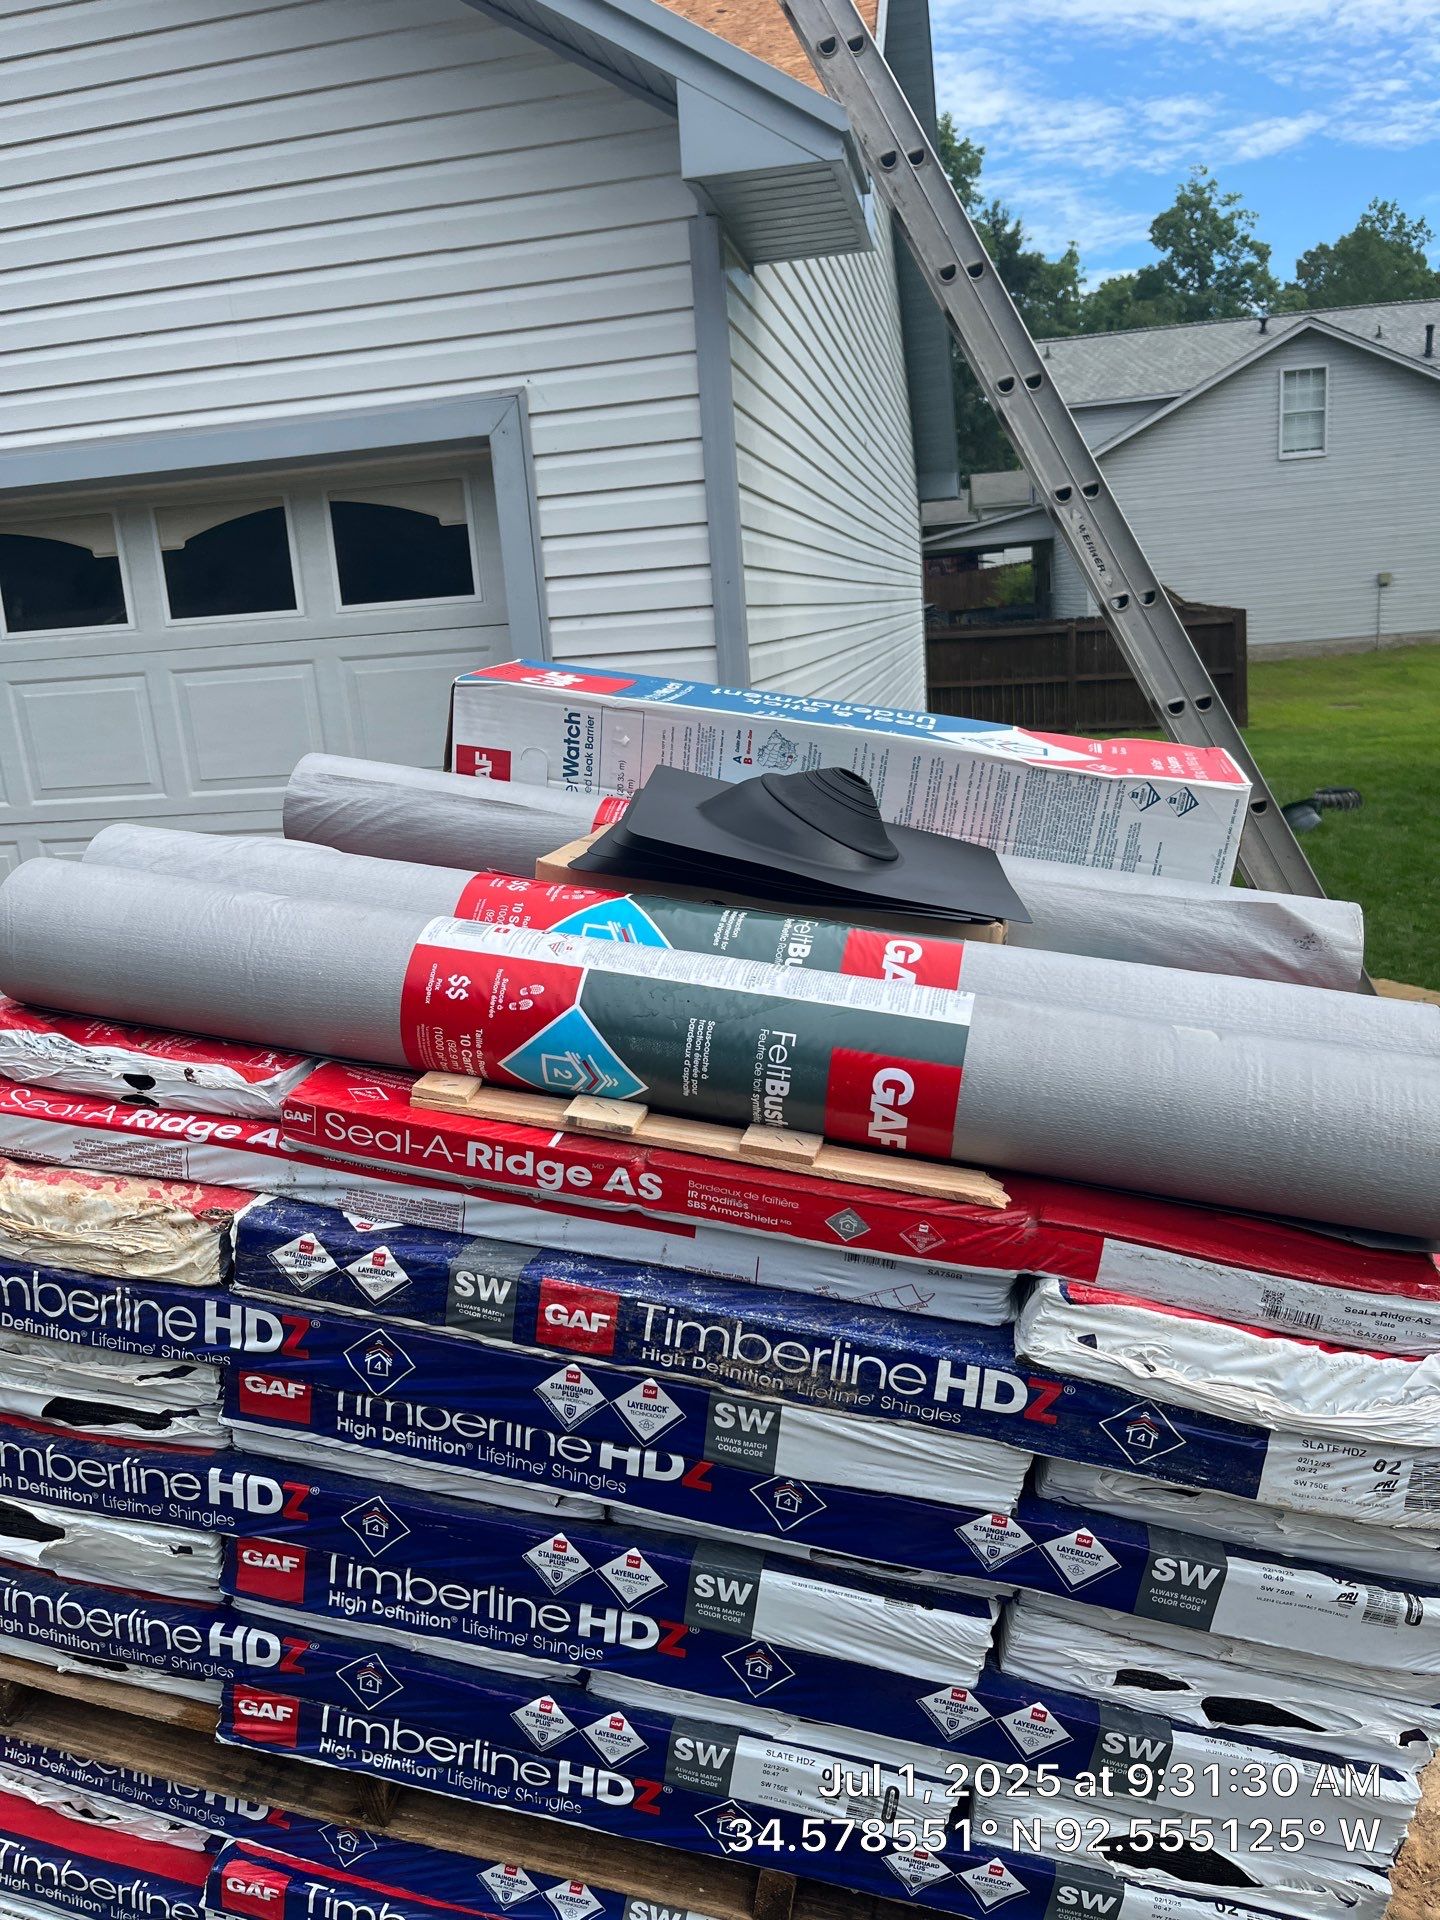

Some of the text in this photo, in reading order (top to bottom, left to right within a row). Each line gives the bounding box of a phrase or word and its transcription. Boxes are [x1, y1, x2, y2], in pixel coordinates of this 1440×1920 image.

[585, 715, 596, 750] Barrier
[474, 751, 493, 778] AF
[584, 751, 595, 780] Leak
[732, 755, 742, 765] A
[743, 757, 753, 765] B
[512, 902, 525, 913] 10
[882, 939, 923, 985] GA
[425, 963, 438, 1005] avantageux
[434, 978, 443, 991] Prix
[488, 968, 504, 1019] traction élevée
[497, 978, 509, 1003] Surface
[433, 1026, 445, 1050] (1000
[460, 1033, 470, 1047] 10
[684, 1017, 698, 1058] bardeaux
[702, 1020, 716, 1072] Sous-couche
[755, 1028, 770, 1060] Feutre
[691, 1019, 707, 1096] traction élevée pour
[754, 1062, 763, 1076] de
[752, 1078, 762, 1092] toit
[283, 1108, 313, 1124] GAF
[868, 1067, 915, 1150] GAF
[324, 1112, 593, 1191] Seal-A-Ridge
[603, 1168, 663, 1201] AS
[688, 1179, 800, 1209] Bardeaux de faîtière
[688, 1190, 750, 1210] IR modifiés
[687, 1200, 708, 1211] SBS
[709, 1203, 779, 1226] ArmorShield
[454, 1270, 512, 1305] SW
[0, 1270, 198, 1342] mberline
[456, 1302, 506, 1318] ALWAYS MATCH
[458, 1308, 502, 1323] COLOR CODE
[1343, 1306, 1368, 1316] Seal
[1380, 1311, 1432, 1326] Ridge-AS
[544, 1304, 611, 1333] GAF
[1374, 1319, 1396, 1329] Slate
[636, 1301, 926, 1395] Timberline
[244, 1375, 306, 1399] GAF
[550, 1381, 594, 1396] STAINGUARD
[562, 1389, 580, 1398] PLUS
[641, 1347, 686, 1368] High
[880, 1396, 962, 1425] Shingles
[627, 1400, 668, 1414] LAYERLOCK
[629, 1409, 666, 1420] TECHNOLOGY
[713, 1402, 775, 1436] SW
[715, 1435, 768, 1450] ALWAYS MATCH
[717, 1443, 764, 1458] COLOR CODE
[1301, 1438, 1367, 1458] SLATE HDZ
[336, 1416, 377, 1439] High
[551, 1463, 627, 1495] Shingles
[1372, 1459, 1402, 1476] 02
[0, 1444, 201, 1500] mberline
[1293, 1479, 1329, 1490] SW 750E
[1373, 1479, 1399, 1490] PRI
[169, 1504, 236, 1527] Shingles
[973, 1524, 1021, 1539] STAINGUARD
[985, 1532, 1004, 1542] PLUS
[242, 1549, 300, 1573] GAF
[1056, 1544, 1101, 1561] LAYERLOCK
[1059, 1553, 1099, 1567] TECHNOLOGY
[611, 1567, 649, 1582] LAYERLOCK
[1151, 1557, 1221, 1591] SW
[329, 1552, 571, 1633] Timberline
[693, 1574, 753, 1606] SW
[1336, 1592, 1359, 1601] PRI
[0, 1577, 202, 1653] imberline
[329, 1590, 367, 1616] High
[533, 1635, 604, 1661] Shingles
[321, 1704, 551, 1786] Timberline
[673, 1737, 730, 1770] SW
[1101, 1731, 1166, 1763] SW
[765, 1749, 816, 1767] SLATE HDZ
[1056, 1885, 1118, 1914] SW
